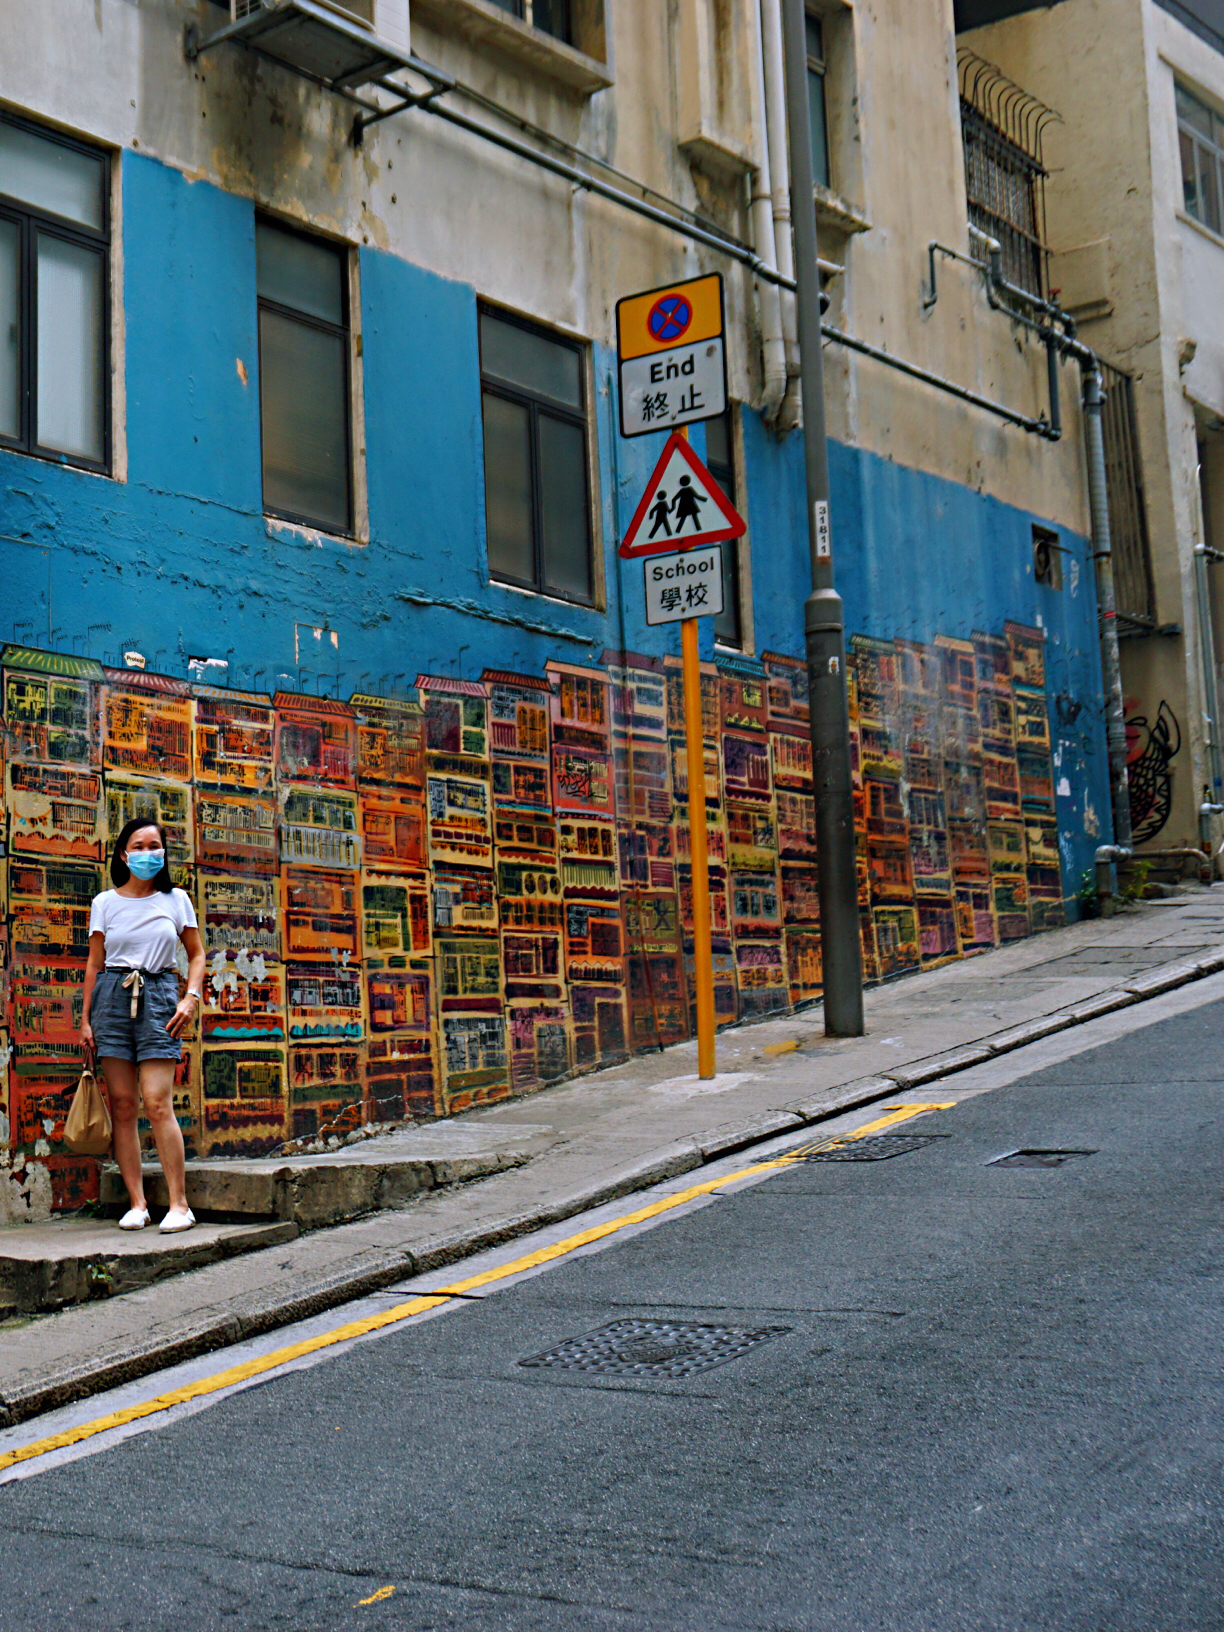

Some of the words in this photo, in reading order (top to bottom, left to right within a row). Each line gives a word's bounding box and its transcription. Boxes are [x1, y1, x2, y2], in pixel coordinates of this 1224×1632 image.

[650, 353, 695, 384] End
[642, 383, 706, 423] 終止
[818, 506, 828, 554] 31811
[653, 556, 714, 581] School
[660, 582, 708, 612] 學校
